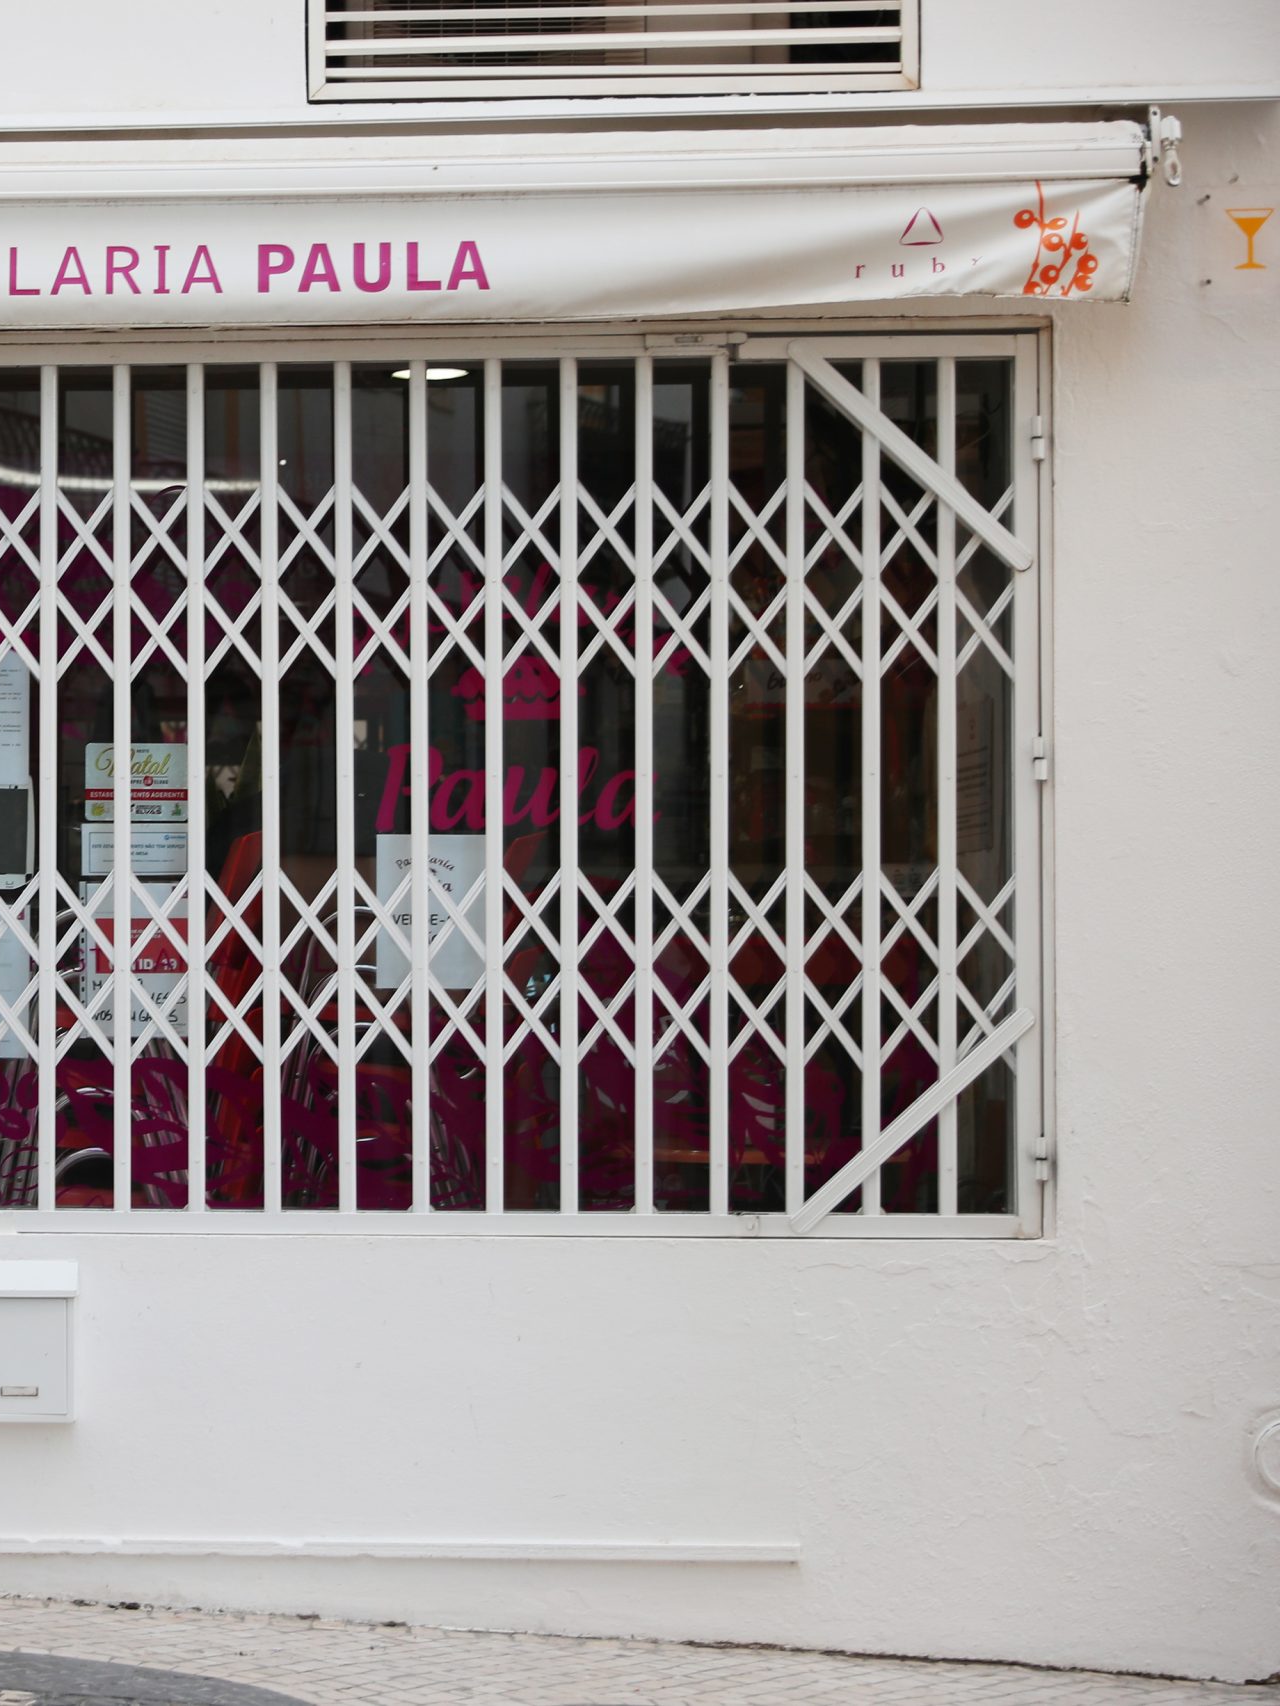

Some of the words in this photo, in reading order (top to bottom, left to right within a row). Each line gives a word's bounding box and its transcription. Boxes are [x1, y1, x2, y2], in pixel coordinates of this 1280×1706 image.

[257, 240, 490, 294] PAULA
[375, 743, 662, 832] Paula
[395, 855, 456, 872] Paaria
